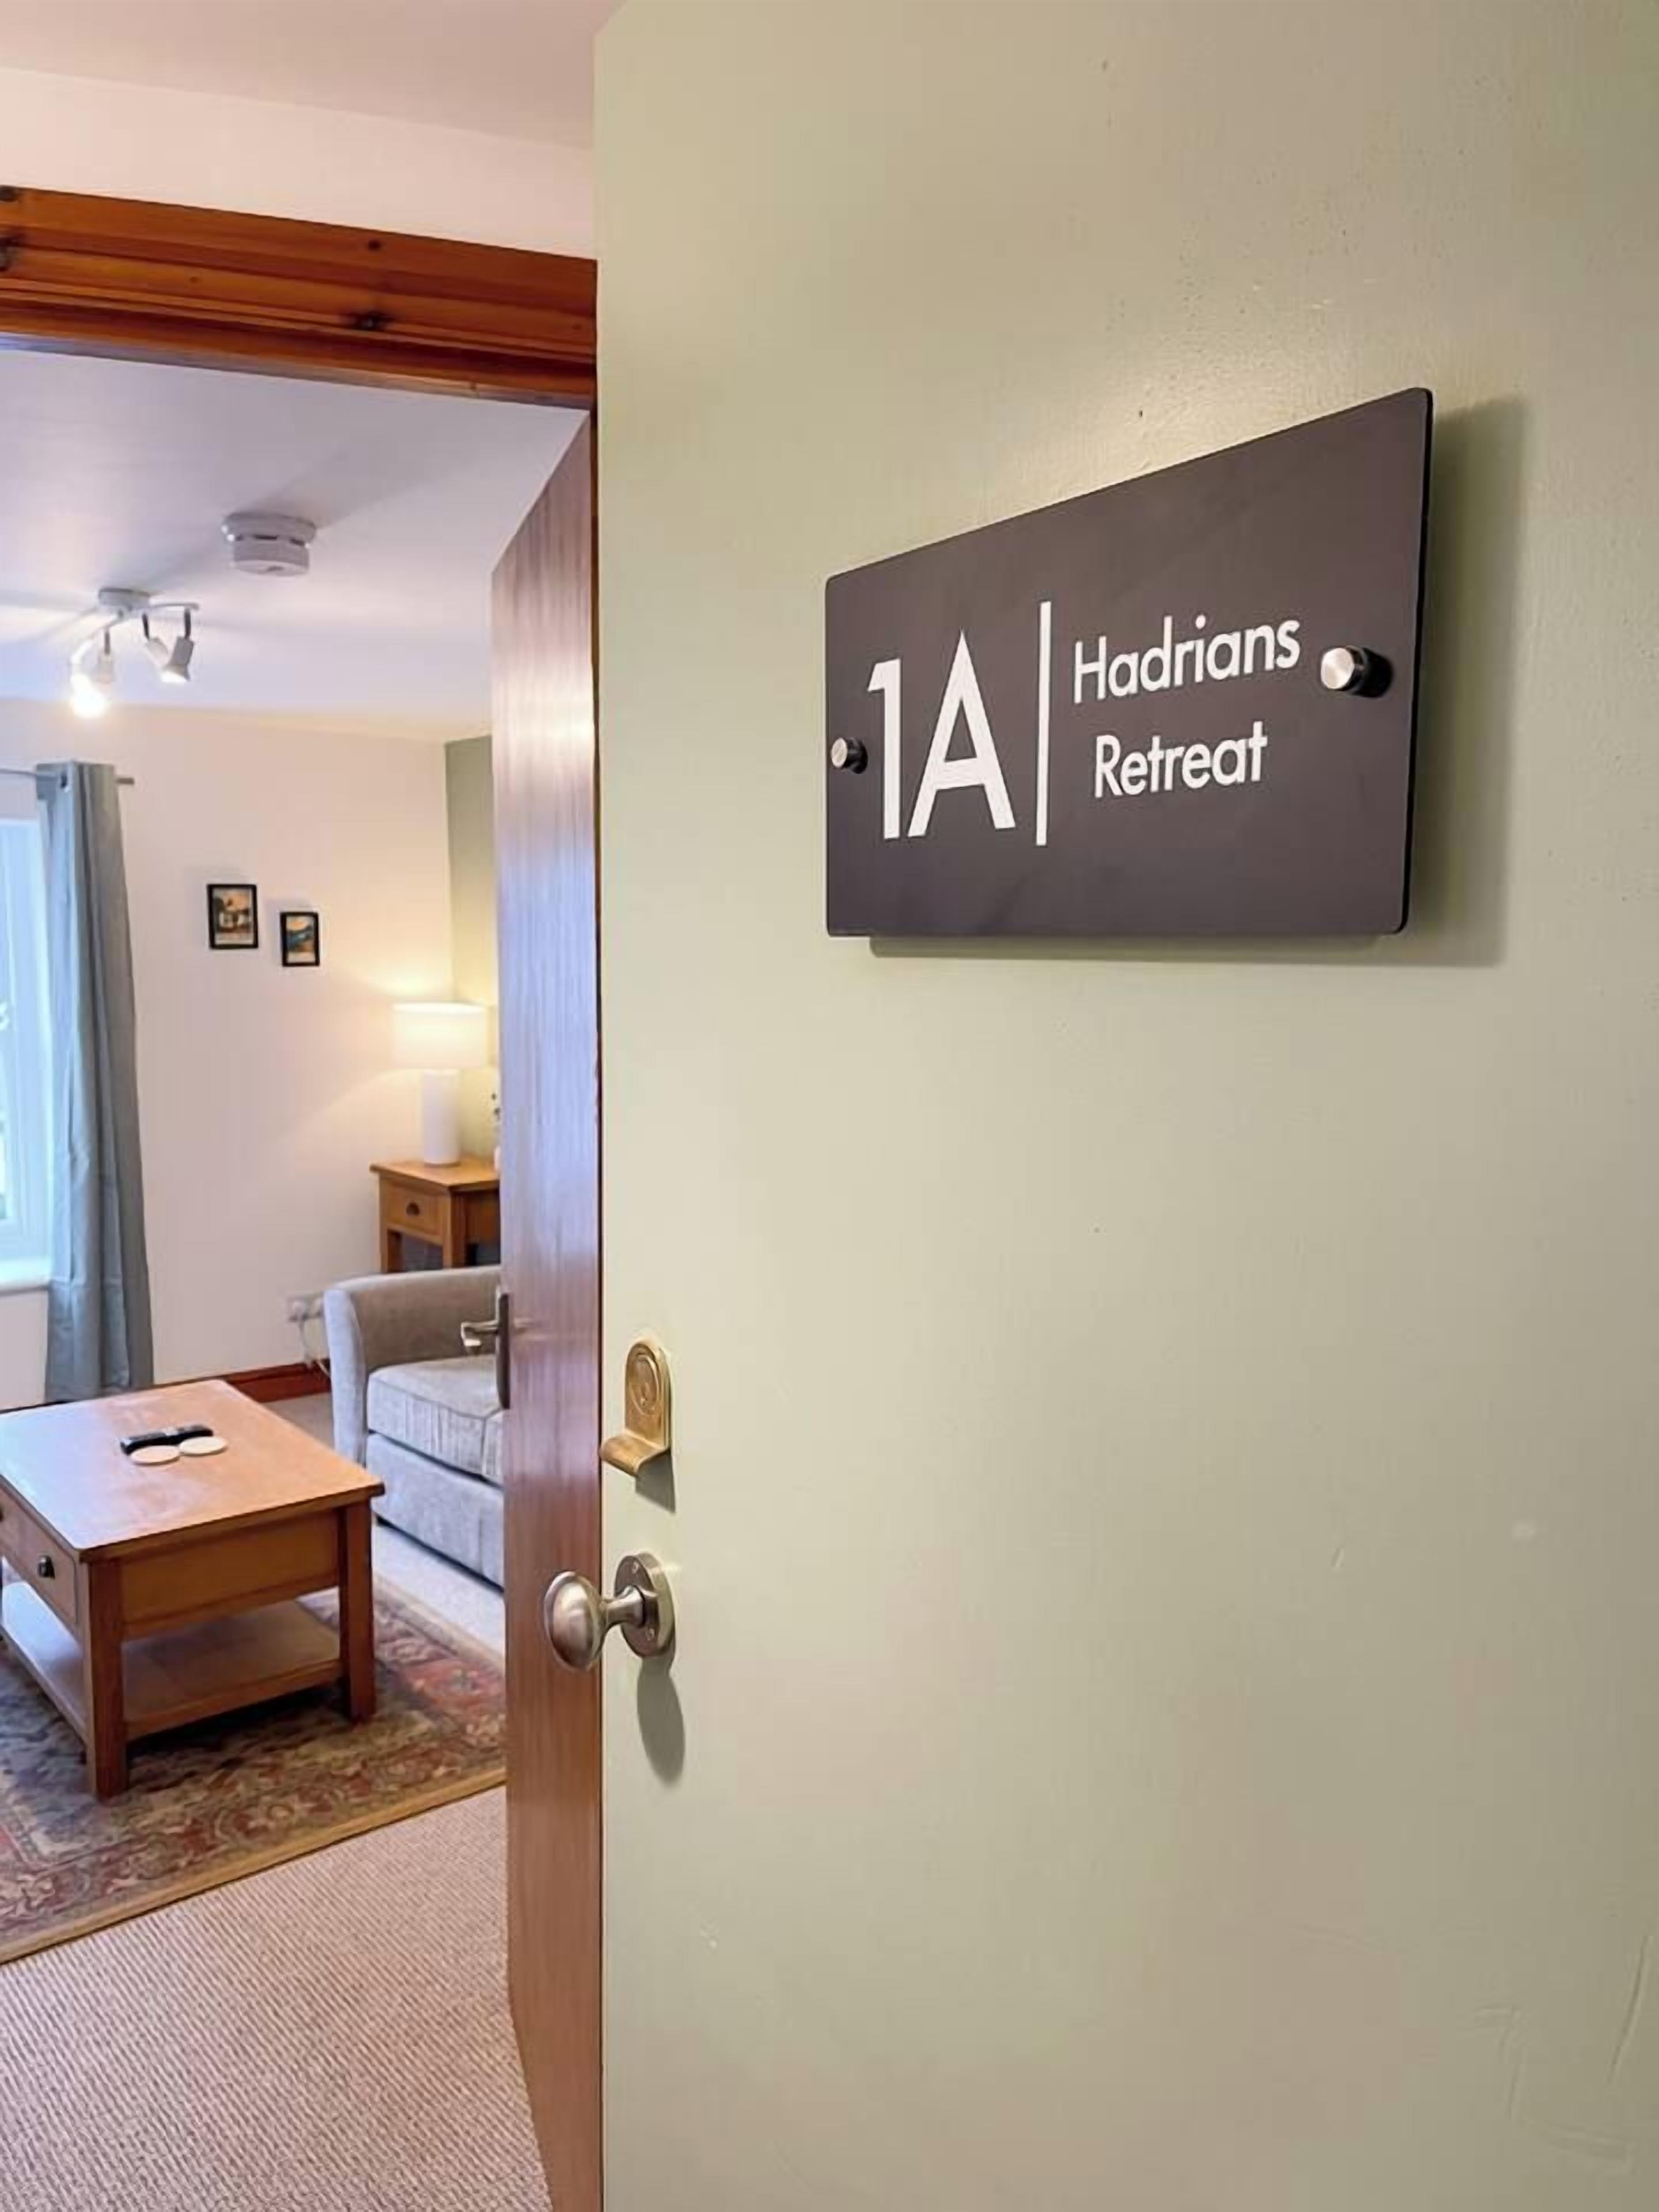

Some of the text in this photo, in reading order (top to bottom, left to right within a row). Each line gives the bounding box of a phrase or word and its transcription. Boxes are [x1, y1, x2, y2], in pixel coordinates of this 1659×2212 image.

[1074, 615, 1301, 704] Hadrians
[867, 630, 1016, 839] 1A
[1094, 721, 1268, 798] Retreat
